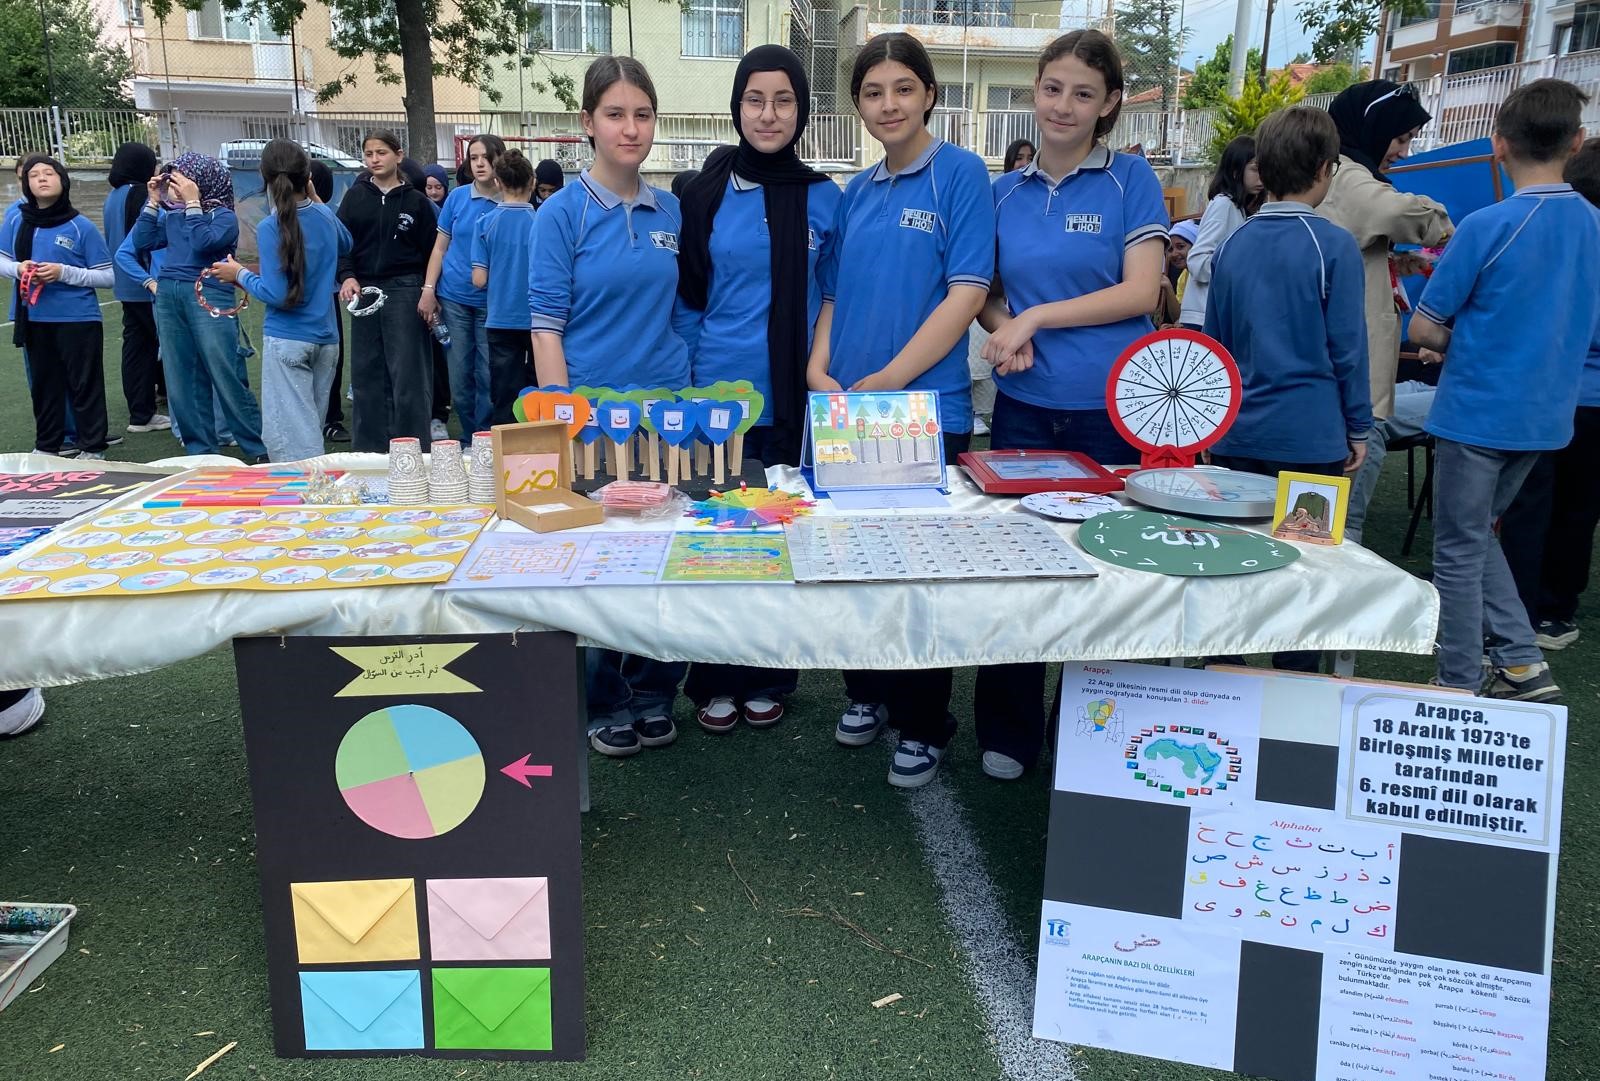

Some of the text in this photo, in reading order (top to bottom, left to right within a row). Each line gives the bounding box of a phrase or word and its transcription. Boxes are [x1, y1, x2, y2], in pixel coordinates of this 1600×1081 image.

[557, 409, 571, 421] ث
[614, 414, 628, 425] ت
[667, 418, 682, 430] ب
[504, 468, 557, 495] ض
[1108, 548, 1128, 557] ٨
[1136, 557, 1159, 566] ٧
[1083, 665, 1113, 675] Arapça;
[1081, 687, 1104, 695] yaygın
[1105, 690, 1143, 699] coğrafyada
[1146, 694, 1182, 703] konuşulan
[1098, 679, 1114, 688] Arap
[1116, 681, 1147, 691] ülkesinin
[1200, 691, 1230, 700] dünyada
[1415, 702, 1489, 725] Arapça,
[1373, 718, 1531, 749] 18 Aralık 1973'te
[1359, 737, 1544, 772] Birleşmiş Milletler
[1395, 762, 1498, 787] tarafından
[1360, 777, 1537, 813] 6. resmî dil olarak
[1270, 820, 1322, 833] Alphabet
[1366, 799, 1527, 833] kabul edilmiştir.
[1197, 822, 1395, 860] أ ب ت ث ج ح خ
[1192, 854, 1391, 885] د ذ ر ز س ش ص
[1189, 872, 1391, 914] ض ط ظ ع غ ف ق
[1227, 908, 1242, 918] و
[1280, 915, 1297, 927] ن
[1310, 919, 1322, 934] م
[1331, 918, 1350, 933] ل
[1366, 924, 1388, 937] ك
[1081, 953, 1195, 977] ARAPÇANIN BAZI DİL ÖZELLİKLERİ
[1339, 959, 1363, 969] zengin
[1364, 963, 1377, 971] söz
[1378, 966, 1417, 977] varlığından
[1418, 972, 1432, 980] pek
[1448, 977, 1474, 986] sözcük
[1475, 981, 1505, 992] almıştır.
[1354, 953, 1397, 966] Günümüzde
[1400, 960, 1424, 970] yaygın
[1427, 964, 1443, 972] olan
[1446, 968, 1460, 976] pek
[1494, 975, 1532, 988] Arapçanın
[1338, 974, 1390, 989] bulunmaktadır.
[1356, 969, 1391, 981] Türkçe'de
[1398, 976, 1411, 984] pek
[1438, 983, 1464, 993] Arapça
[1470, 988, 1497, 999] kökenli
[1504, 995, 1531, 1004] sözcük
